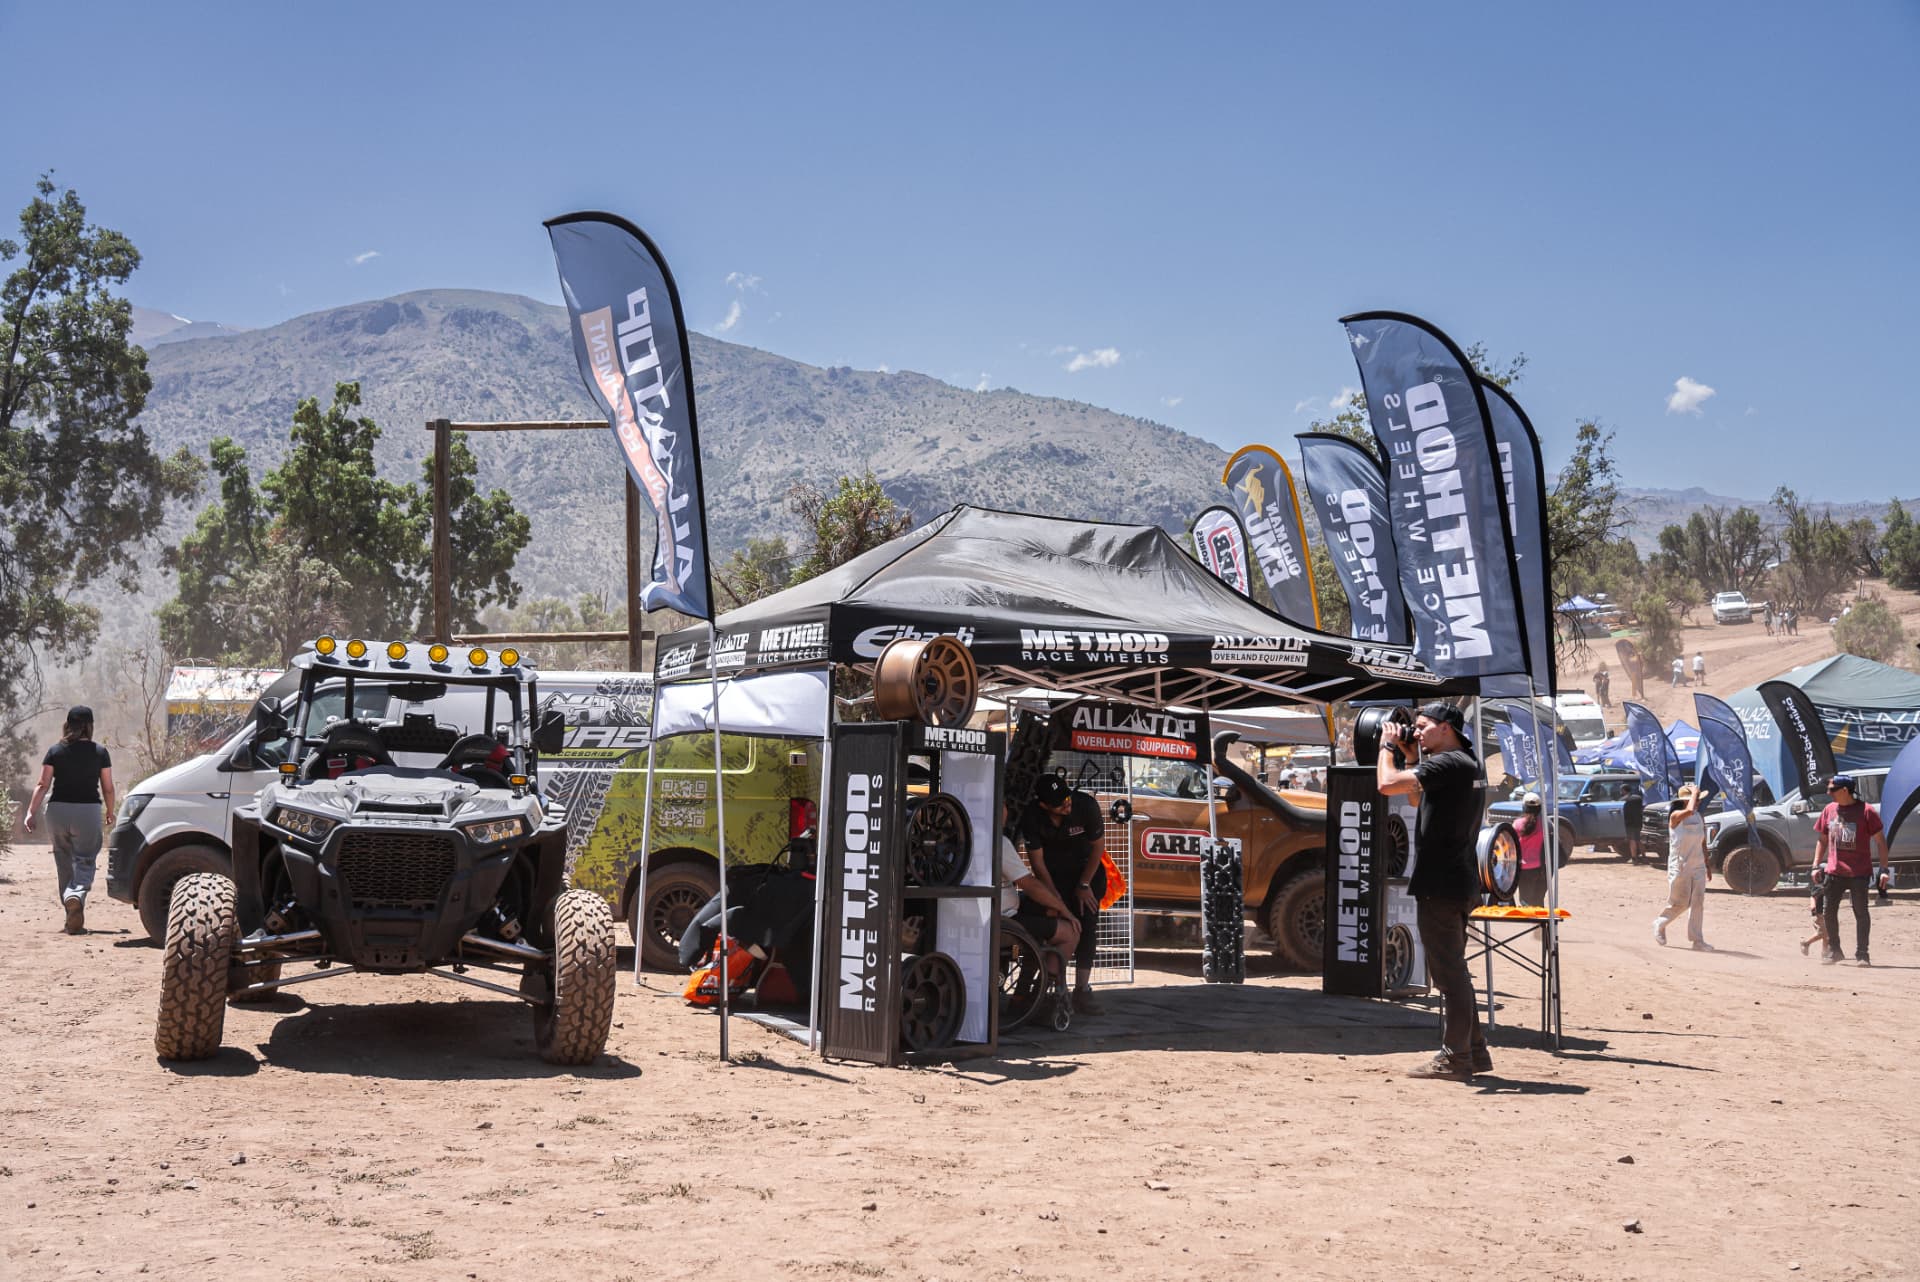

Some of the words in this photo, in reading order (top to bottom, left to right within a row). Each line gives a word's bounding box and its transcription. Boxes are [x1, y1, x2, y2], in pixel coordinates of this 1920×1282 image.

[759, 623, 825, 652] METHOD
[852, 625, 976, 658] Eibah
[1020, 629, 1170, 653] METHOD
[757, 652, 779, 665] RACE
[783, 647, 823, 662] WHEELS
[1022, 651, 1075, 662] RACE
[1086, 653, 1169, 664] WHEELS
[1213, 652, 1258, 662] OVERLAND
[1259, 654, 1306, 664] EQUIPMENT
[924, 727, 987, 745] METHOD
[924, 740, 947, 749] RACE
[951, 743, 986, 752] WHEELS
[1077, 735, 1133, 750] OVERLAND
[1136, 741, 1193, 755] EQUIPMENT
[867, 774, 884, 909] WHEELS
[1360, 801, 1372, 894] WHEELS
[839, 773, 870, 1012] METHOD
[1337, 801, 1361, 962] METHOD
[1358, 907, 1370, 963] RACE
[864, 929, 878, 1013] RACE
